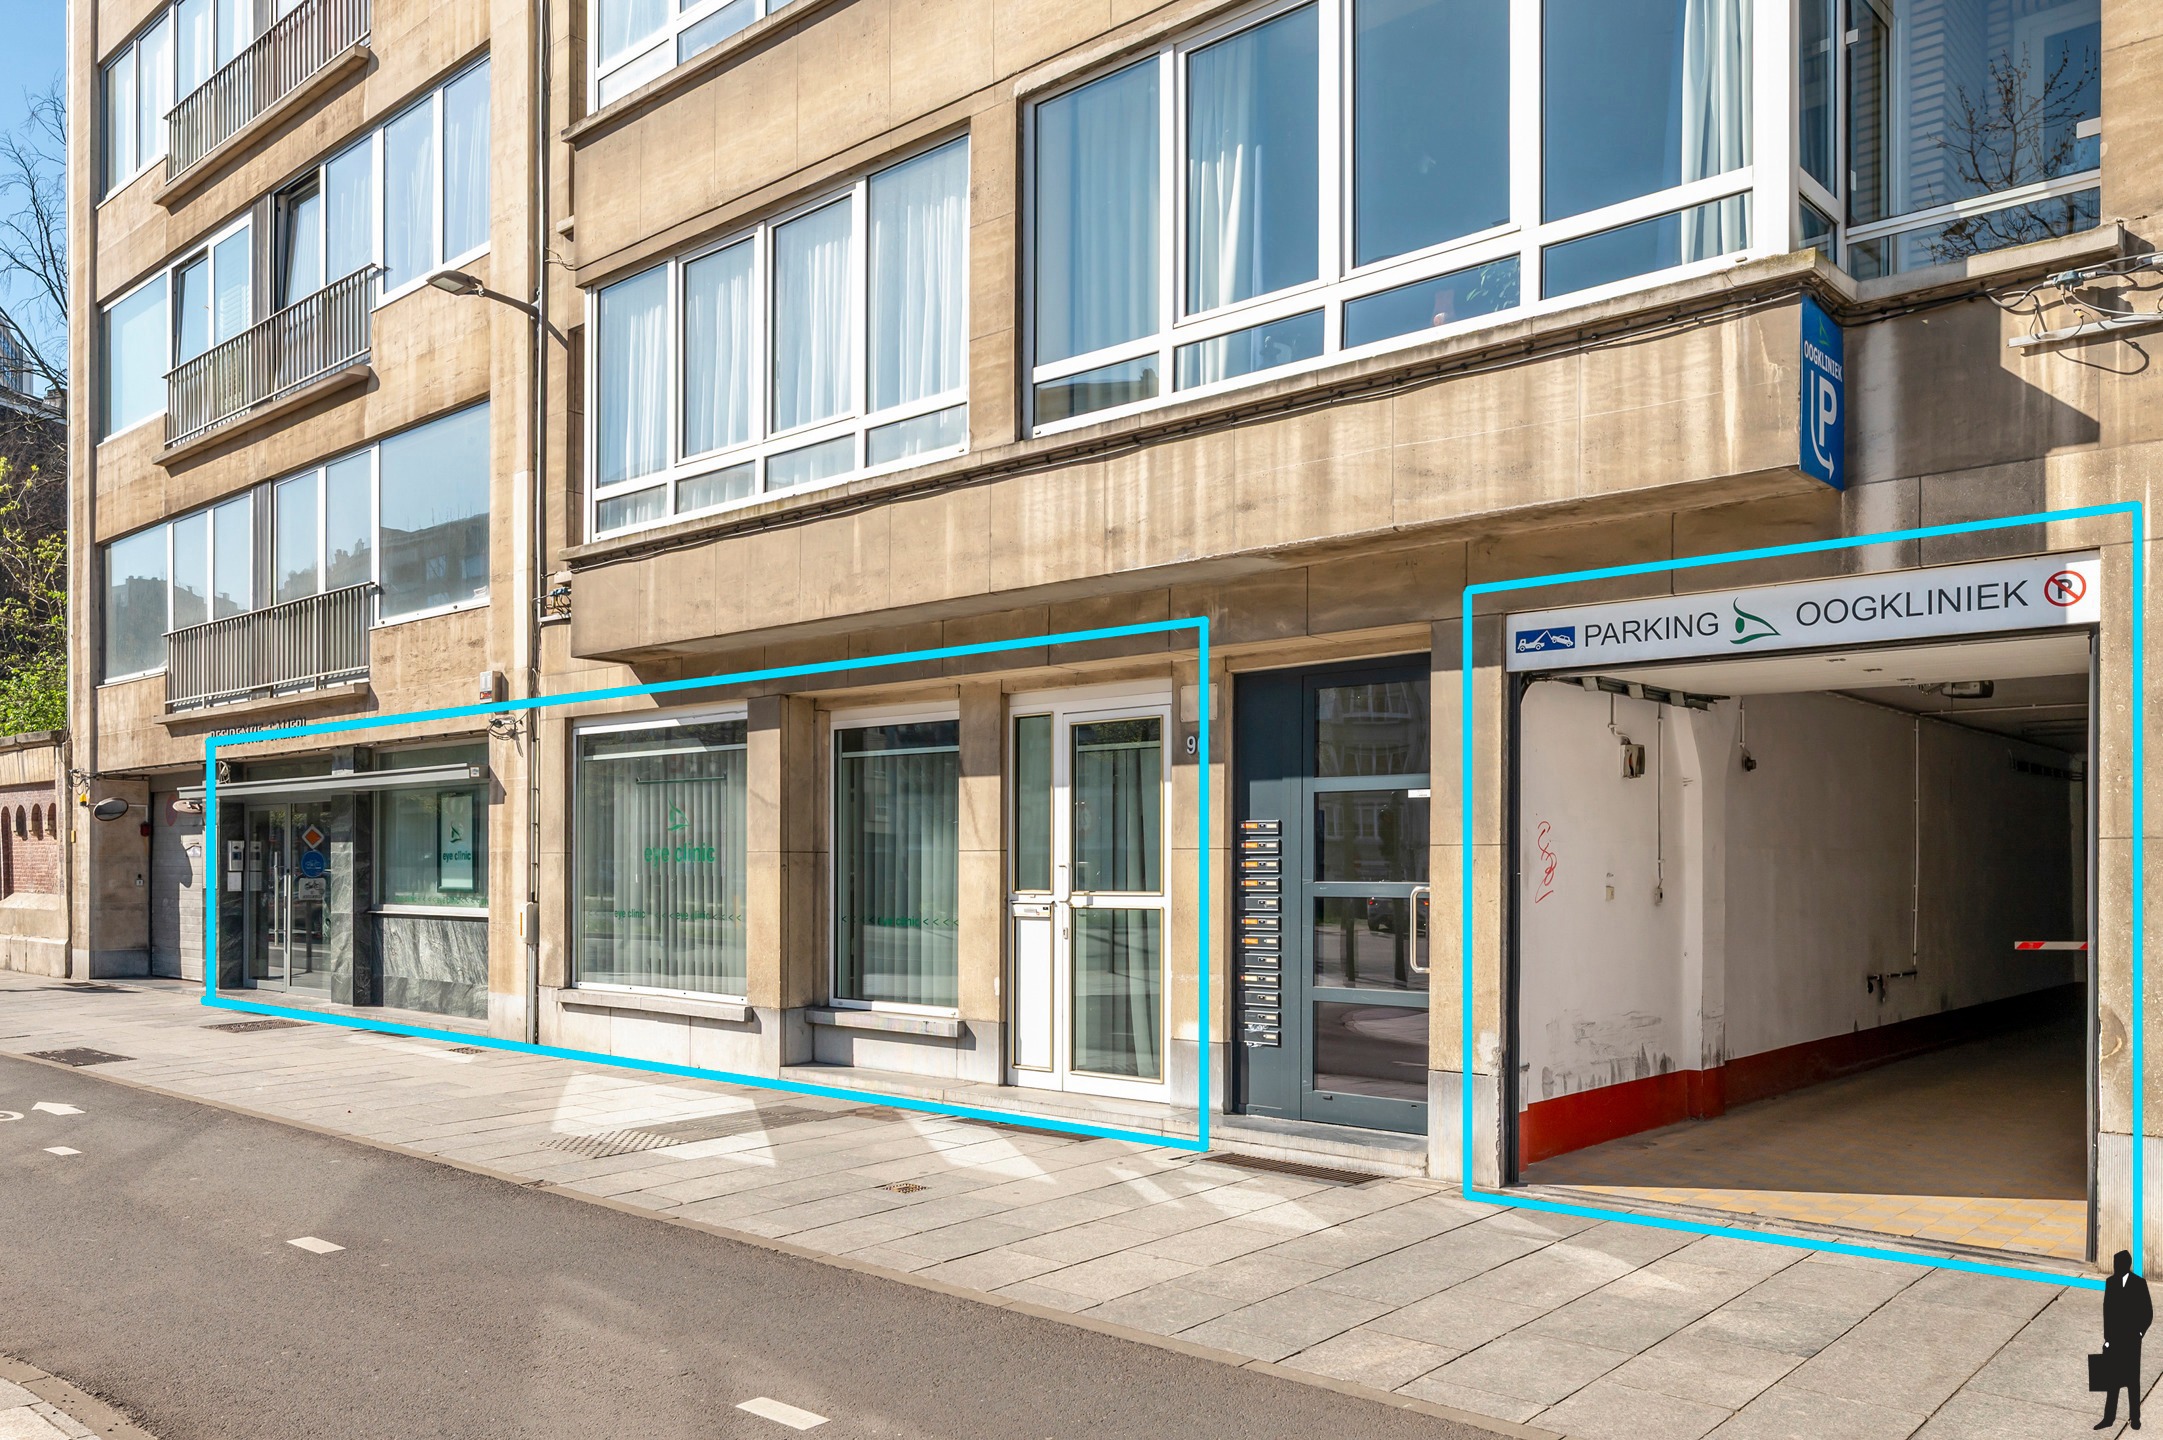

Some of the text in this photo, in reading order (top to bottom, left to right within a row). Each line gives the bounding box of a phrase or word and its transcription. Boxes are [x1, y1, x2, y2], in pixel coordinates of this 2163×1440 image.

[1804, 340, 1843, 382] OOGKLINIEK
[1819, 375, 1837, 447] P
[1585, 612, 1719, 647] PARKING
[1796, 580, 2029, 626] OOGKLINIEK
[1186, 735, 1201, 755] 9
[443, 851, 471, 863] eye clinic
[644, 842, 715, 868] eye clinic
[614, 910, 626, 920] eye
[627, 908, 646, 919] clinic
